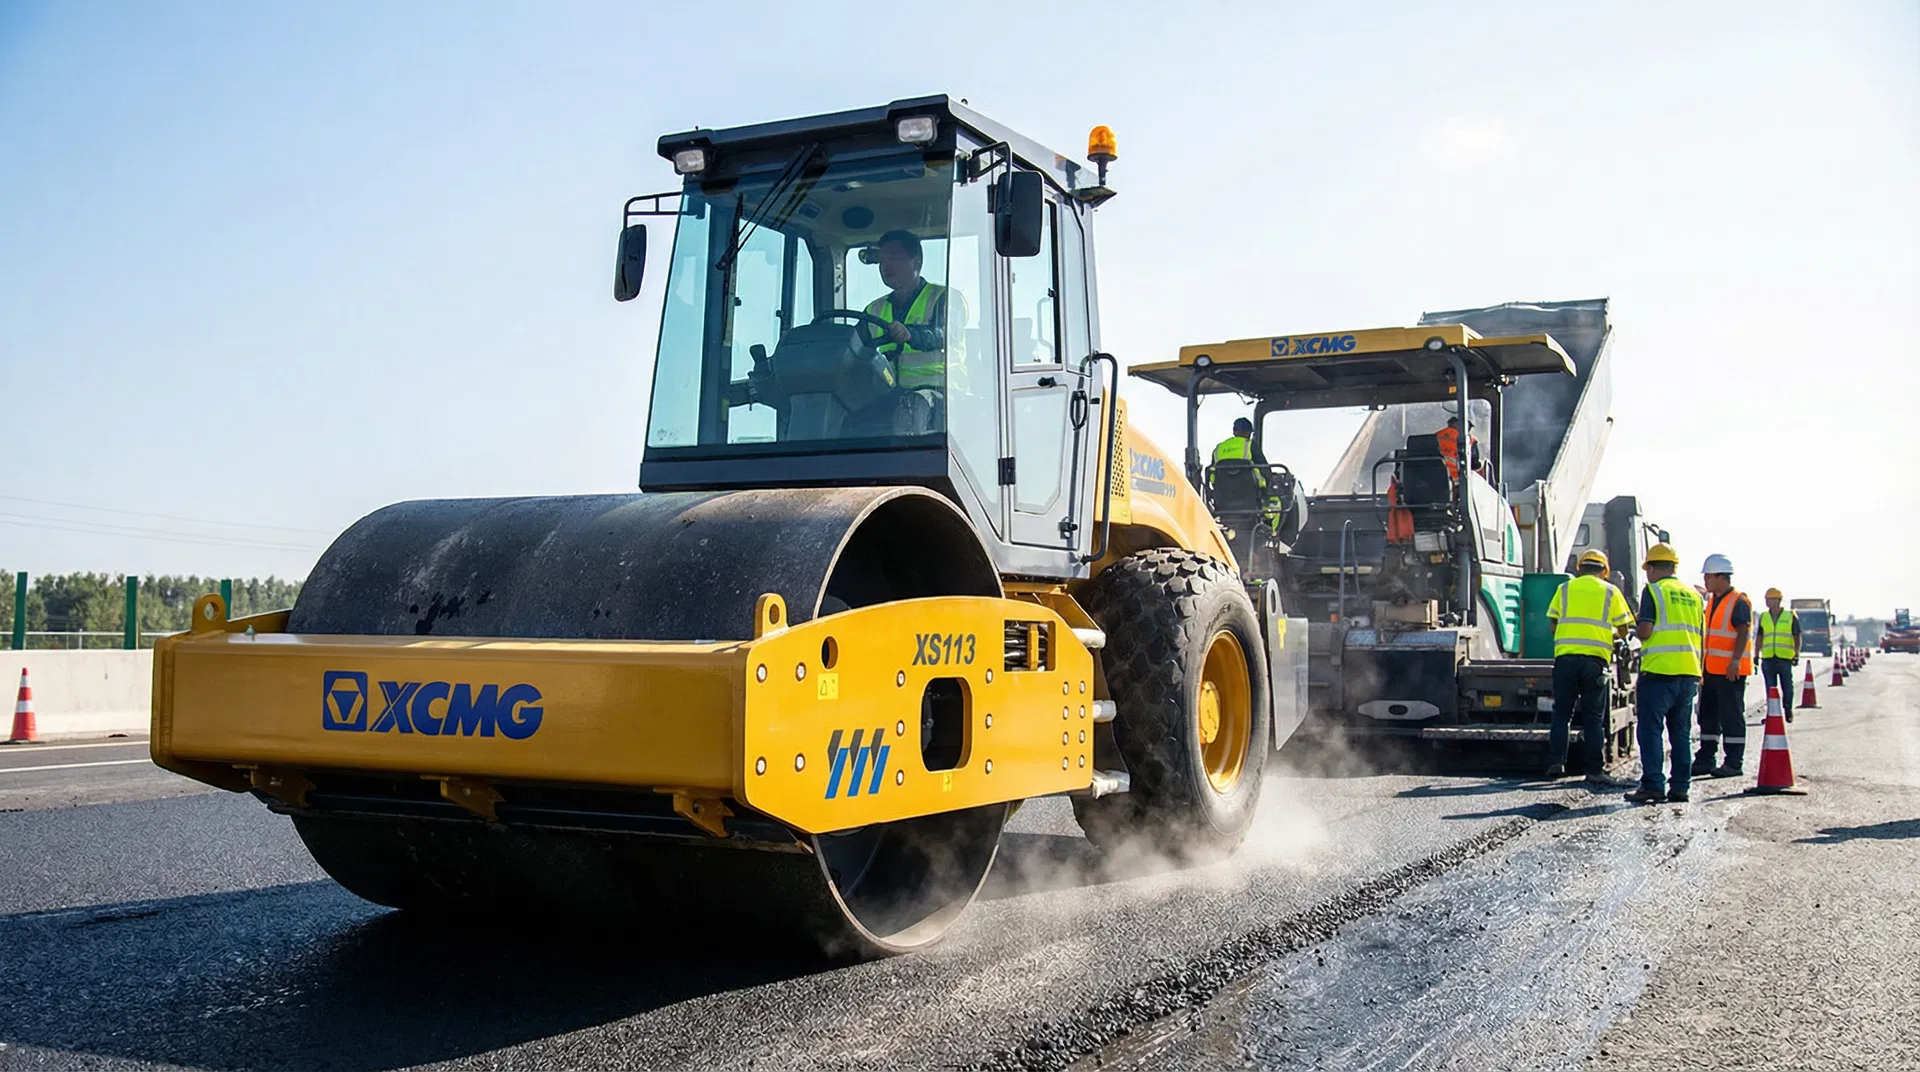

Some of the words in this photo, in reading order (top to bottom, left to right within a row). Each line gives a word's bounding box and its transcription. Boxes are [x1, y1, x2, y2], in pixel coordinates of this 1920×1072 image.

[1291, 335, 1356, 355] XCMG
[1131, 452, 1165, 480] XCMG
[912, 633, 976, 666] XS113
[369, 681, 544, 740] XCMG
